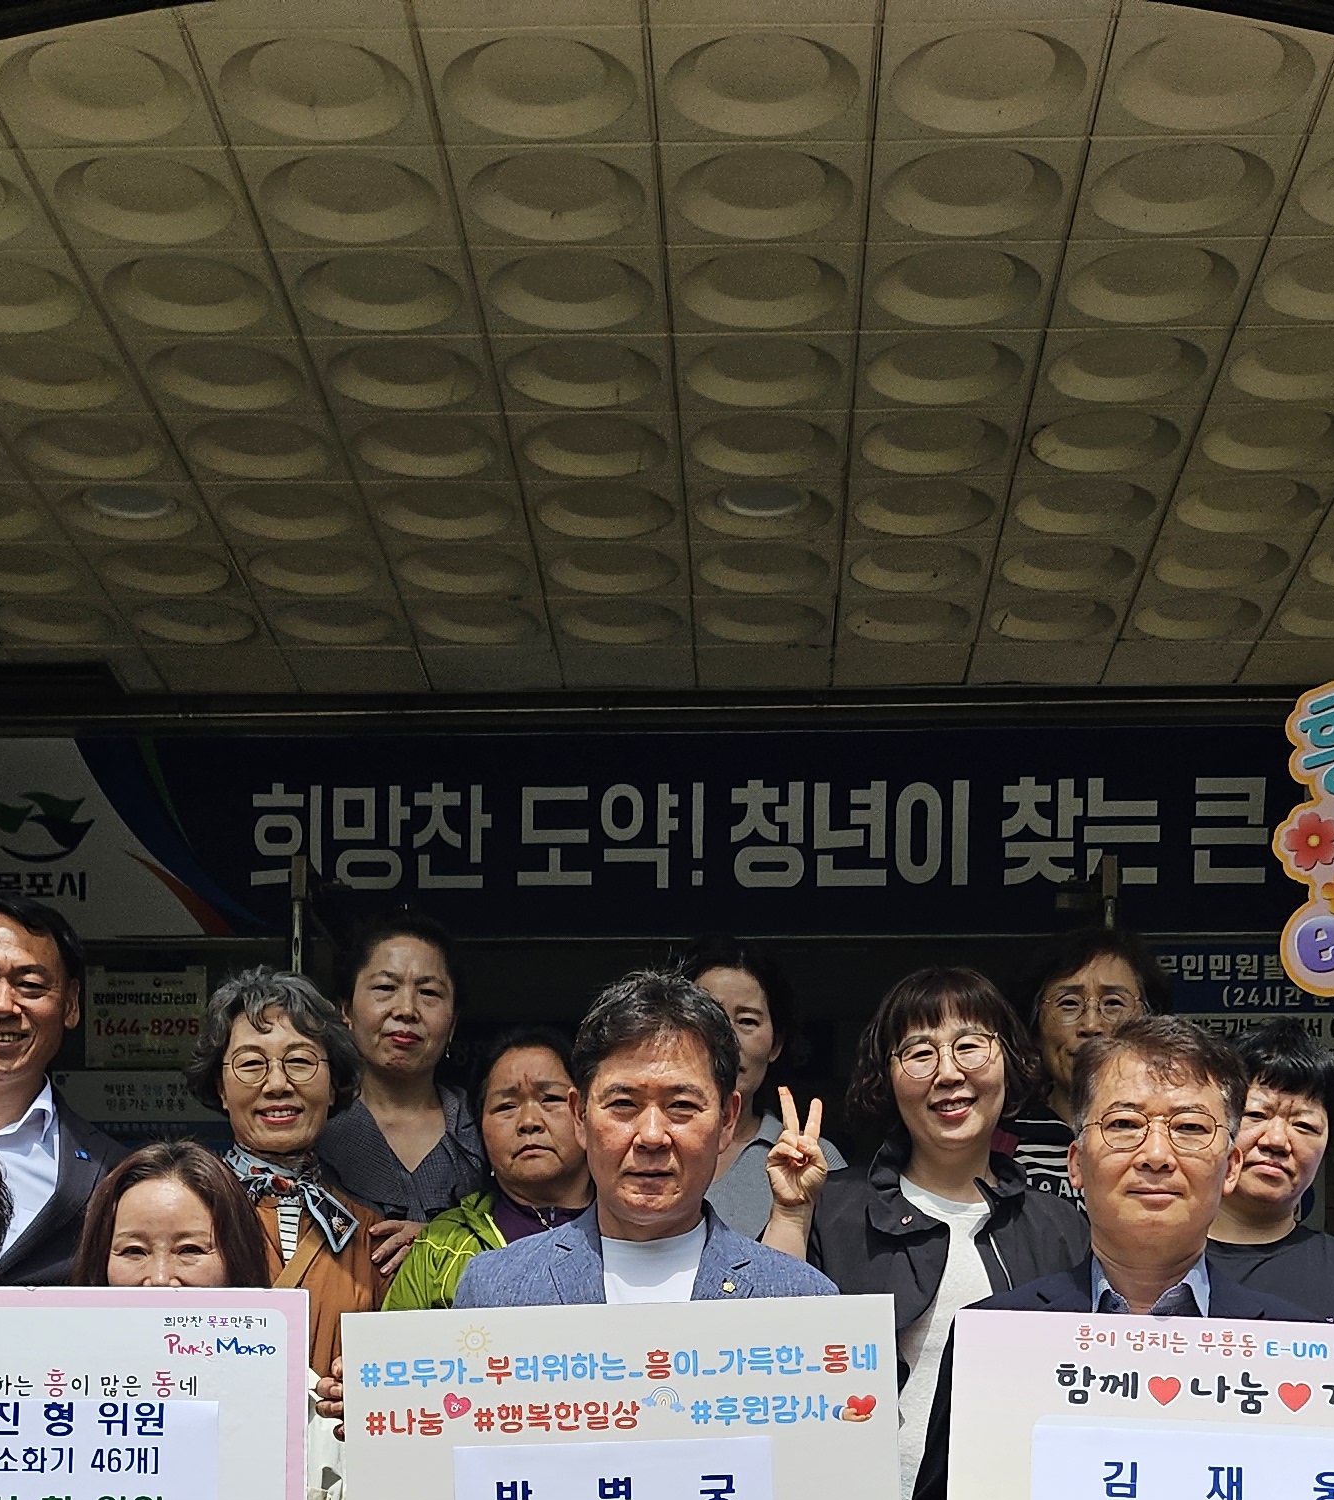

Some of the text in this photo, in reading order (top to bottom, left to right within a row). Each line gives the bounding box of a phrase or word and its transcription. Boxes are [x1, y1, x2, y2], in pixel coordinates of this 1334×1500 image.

[251, 776, 1268, 889] 희망찬 도약! 청년이 찾는 큰
[1156, 954, 1284, 981] 무인민원발
[1223, 986, 1303, 1007] (24시간
[93, 1018, 199, 1036] 1644-8295
[163, 1315, 203, 1329] 희망찬
[1074, 1324, 1117, 1352] 흥이
[1125, 1328, 1188, 1355] 넘치는
[1197, 1331, 1258, 1358] 부흥동
[1266, 1339, 1328, 1359] E-UM
[43, 1369, 90, 1396] 흥이
[99, 1372, 142, 1396] 많은
[151, 1369, 198, 1397] 동네
[1055, 1363, 1140, 1405] 함께
[1190, 1372, 1269, 1414] 나눔
[97, 1401, 166, 1438] 위원
[365, 1393, 830, 1437] #나눔 #행복한일상 #후원감사
[89, 1445, 159, 1475] 46개]
[1103, 1461, 1139, 1499] 김
